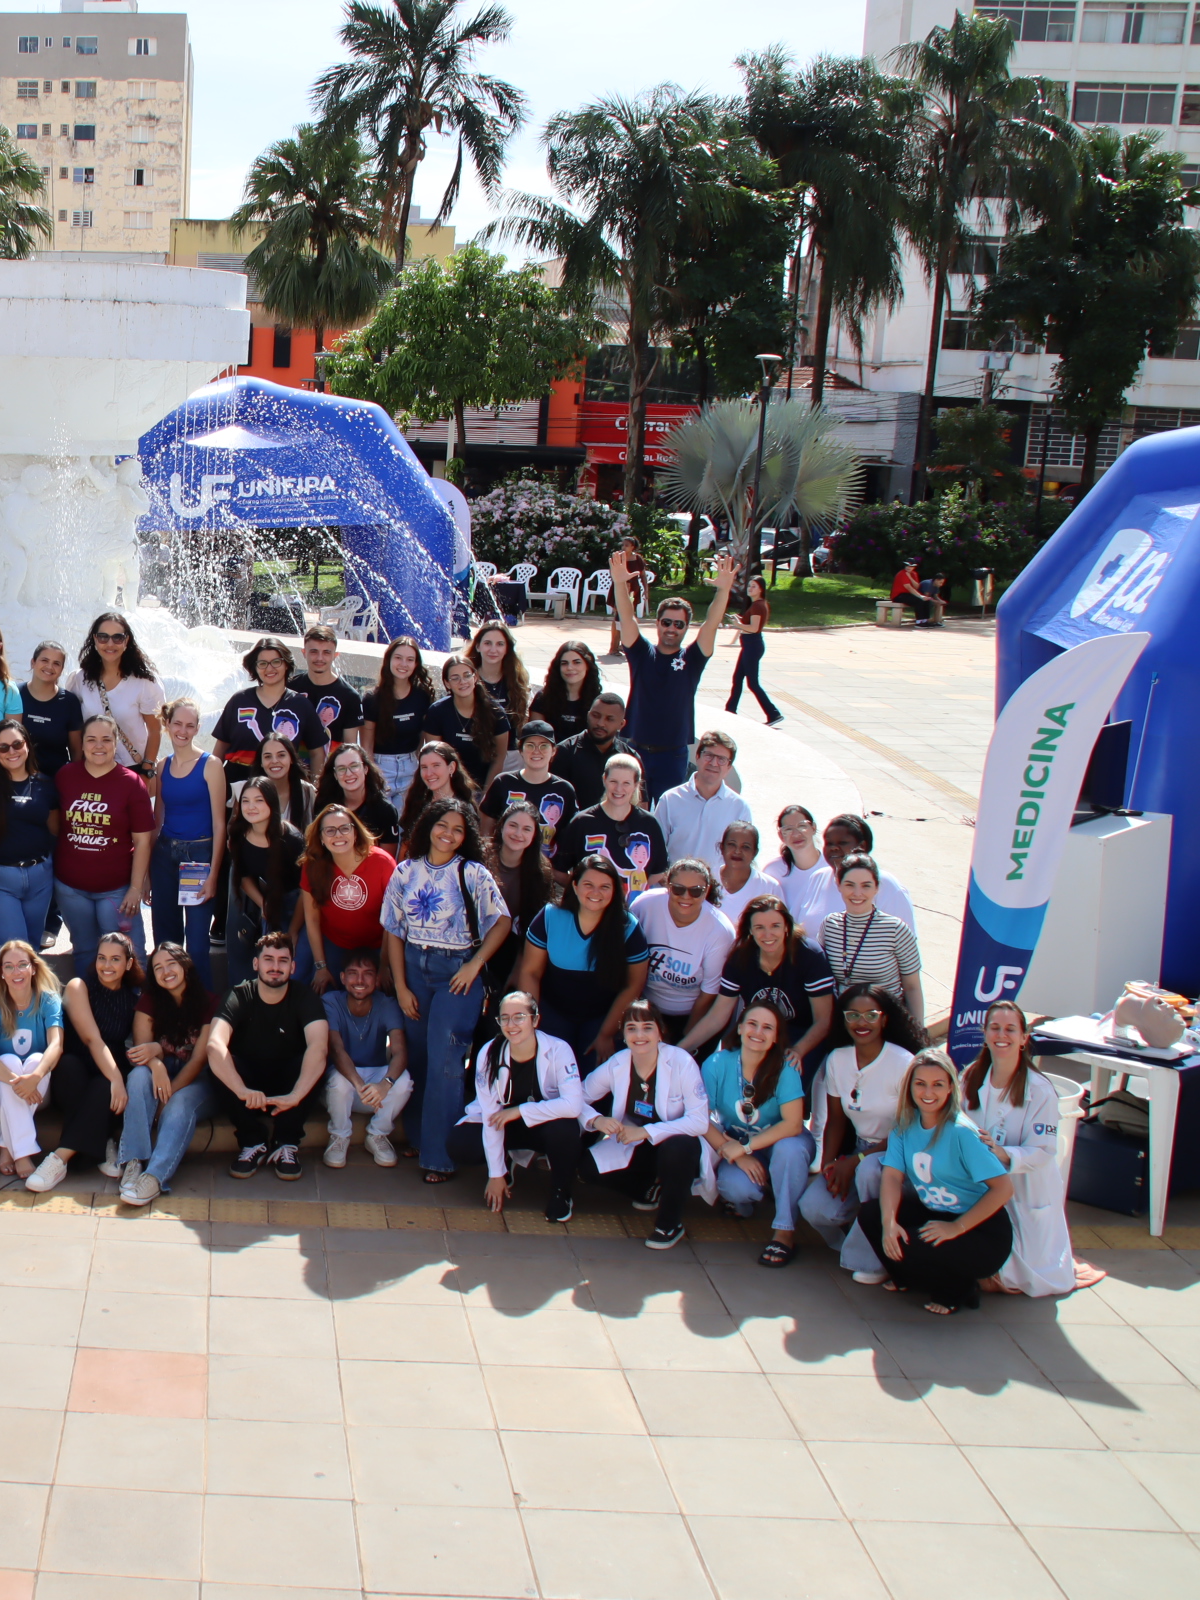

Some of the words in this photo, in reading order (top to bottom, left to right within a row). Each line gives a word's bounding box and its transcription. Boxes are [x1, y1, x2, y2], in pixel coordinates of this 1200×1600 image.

[238, 475, 337, 497] UNIFIPA
[81, 792, 102, 801] #EU
[1006, 702, 1076, 881] MEDICINA
[69, 800, 108, 813] FAÇO
[65, 810, 111, 825] PARTE
[72, 826, 95, 836] TIME
[662, 971, 697, 985] colégio
